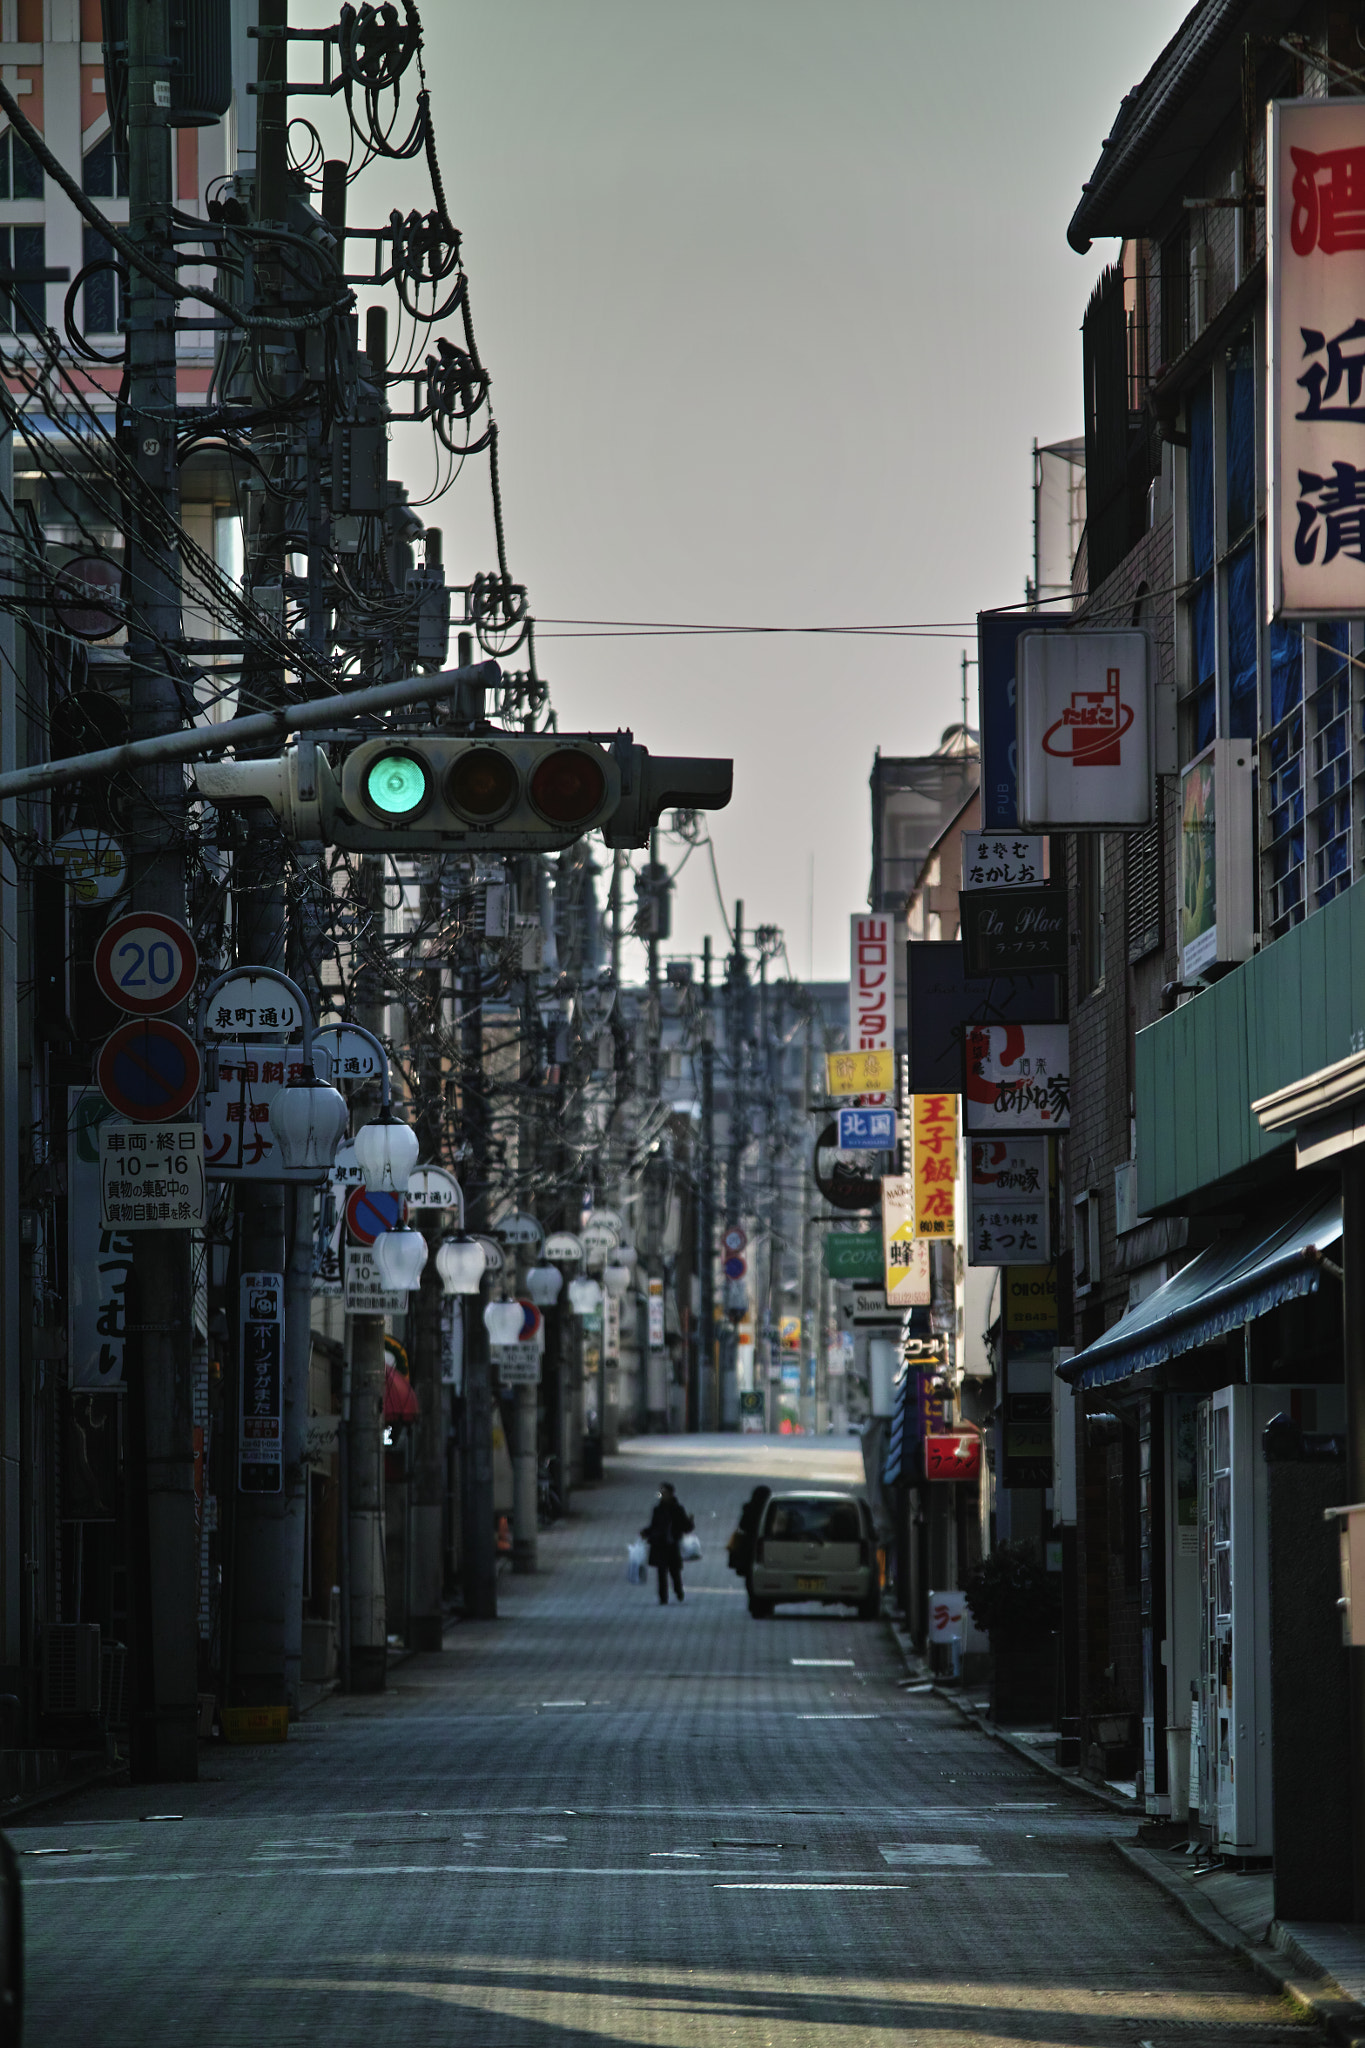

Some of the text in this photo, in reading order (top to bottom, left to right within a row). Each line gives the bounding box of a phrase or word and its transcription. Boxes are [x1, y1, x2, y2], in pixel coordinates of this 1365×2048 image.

[1062, 704, 1113, 725] たばこ
[997, 784, 1009, 814] PUB
[969, 863, 1035, 883] たかしお
[979, 906, 1063, 936] La Place
[119, 942, 174, 986] 20
[215, 1007, 294, 1028] 泉町通り
[843, 1113, 891, 1136] 北国
[107, 1131, 196, 1152] 車両・終日
[919, 1096, 954, 1217] 王子飯店
[107, 1179, 189, 1197] 貨物の集配中の
[107, 1202, 199, 1221] 貨物自動車を除く
[978, 1230, 1038, 1251] まつた
[890, 1241, 914, 1266] 蜂
